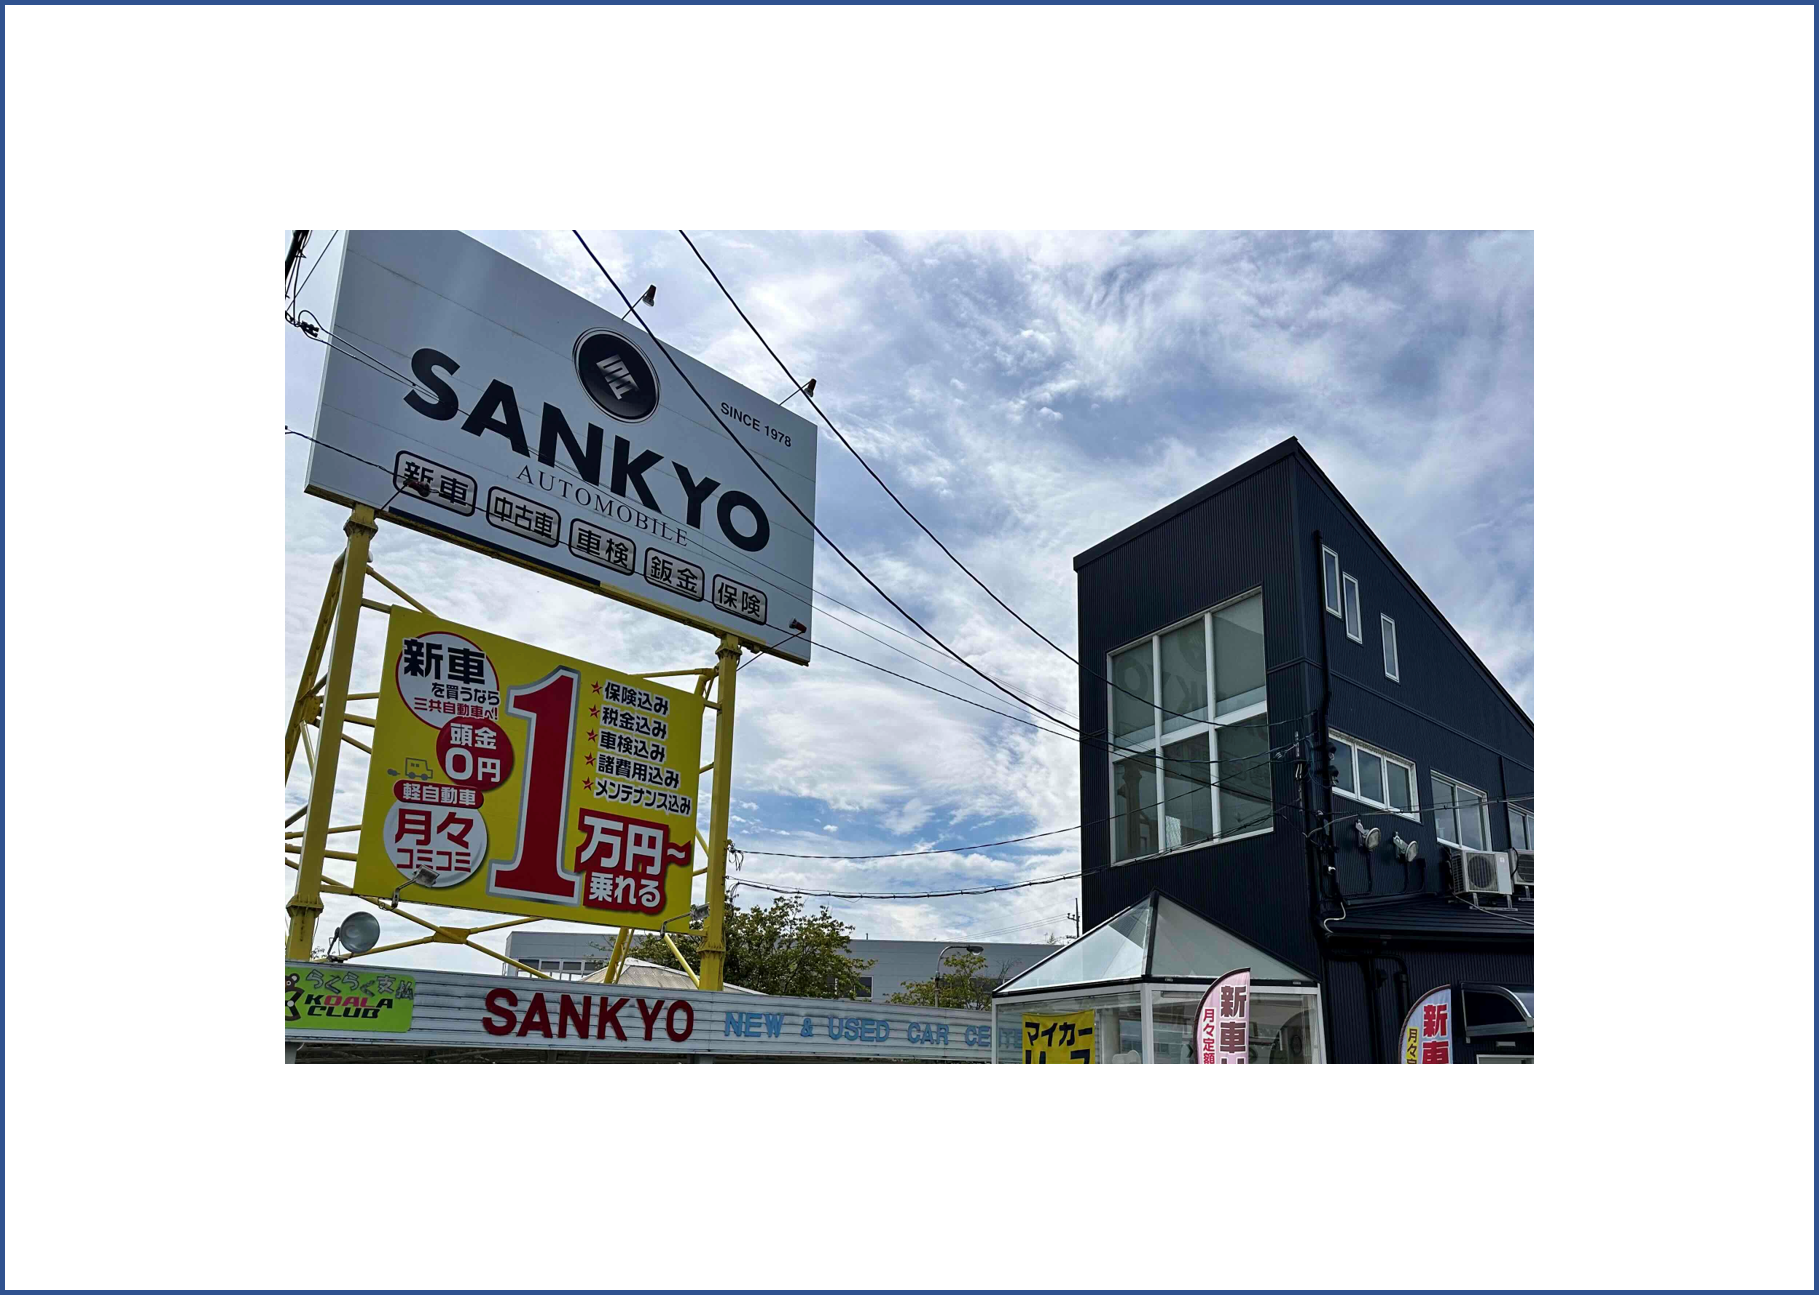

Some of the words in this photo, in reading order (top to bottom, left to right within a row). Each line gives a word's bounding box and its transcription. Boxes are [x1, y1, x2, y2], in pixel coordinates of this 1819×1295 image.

[720, 402, 760, 432] SINCE
[764, 425, 792, 447] 1978
[403, 348, 770, 552] SANKYO
[494, 496, 554, 539] 中古車
[516, 464, 688, 547] AUTOMOBILE
[576, 527, 629, 569] 車検
[650, 555, 698, 594] 鈑金
[718, 582, 760, 617] 保険
[403, 638, 485, 685] 新車
[432, 682, 500, 706] を買うなら
[604, 681, 668, 716] 保険込み
[450, 722, 497, 750] 頭金
[602, 706, 667, 739] 税金込み
[600, 730, 665, 762] 車検込み
[445, 747, 501, 783] 0円
[598, 753, 679, 789] 諸費用込み
[402, 782, 476, 806] 軽自動車
[490, 668, 580, 905] 1
[595, 780, 691, 815] メンテナンス込み
[395, 808, 474, 850] 月々
[396, 848, 471, 873] コミコミ
[589, 871, 660, 907] 乗れる
[305, 994, 393, 1009] KOALA
[307, 1005, 380, 1019] CLUB
[482, 988, 694, 1042] SANKYO
[724, 1012, 785, 1038] NEW
[801, 1018, 813, 1037] &
[828, 1016, 890, 1042] USED
[907, 1022, 949, 1045] CAR
[1025, 1022, 1093, 1047] マイカー
[1423, 1004, 1449, 1064] 新車
